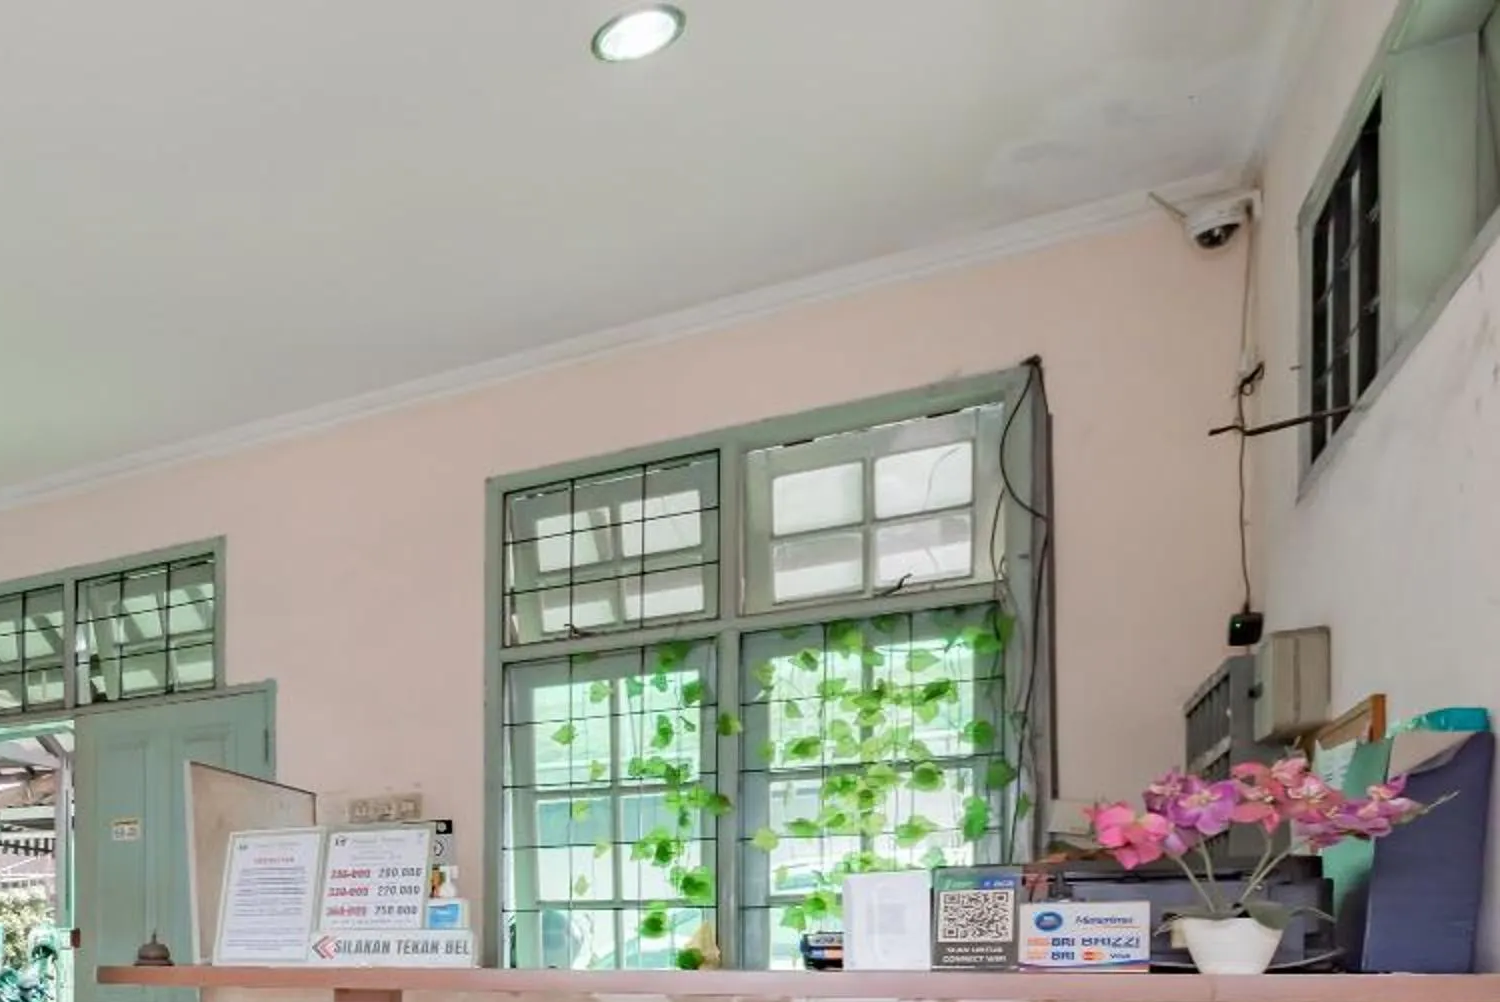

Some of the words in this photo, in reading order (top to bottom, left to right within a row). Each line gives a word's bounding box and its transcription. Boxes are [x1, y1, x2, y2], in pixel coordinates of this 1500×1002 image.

[334, 939, 391, 955] SILAKAN
[396, 939, 440, 955] TEKAN
[444, 939, 470, 955] BEL
[1051, 937, 1076, 947] BRI
[1051, 951, 1075, 961] BRI
